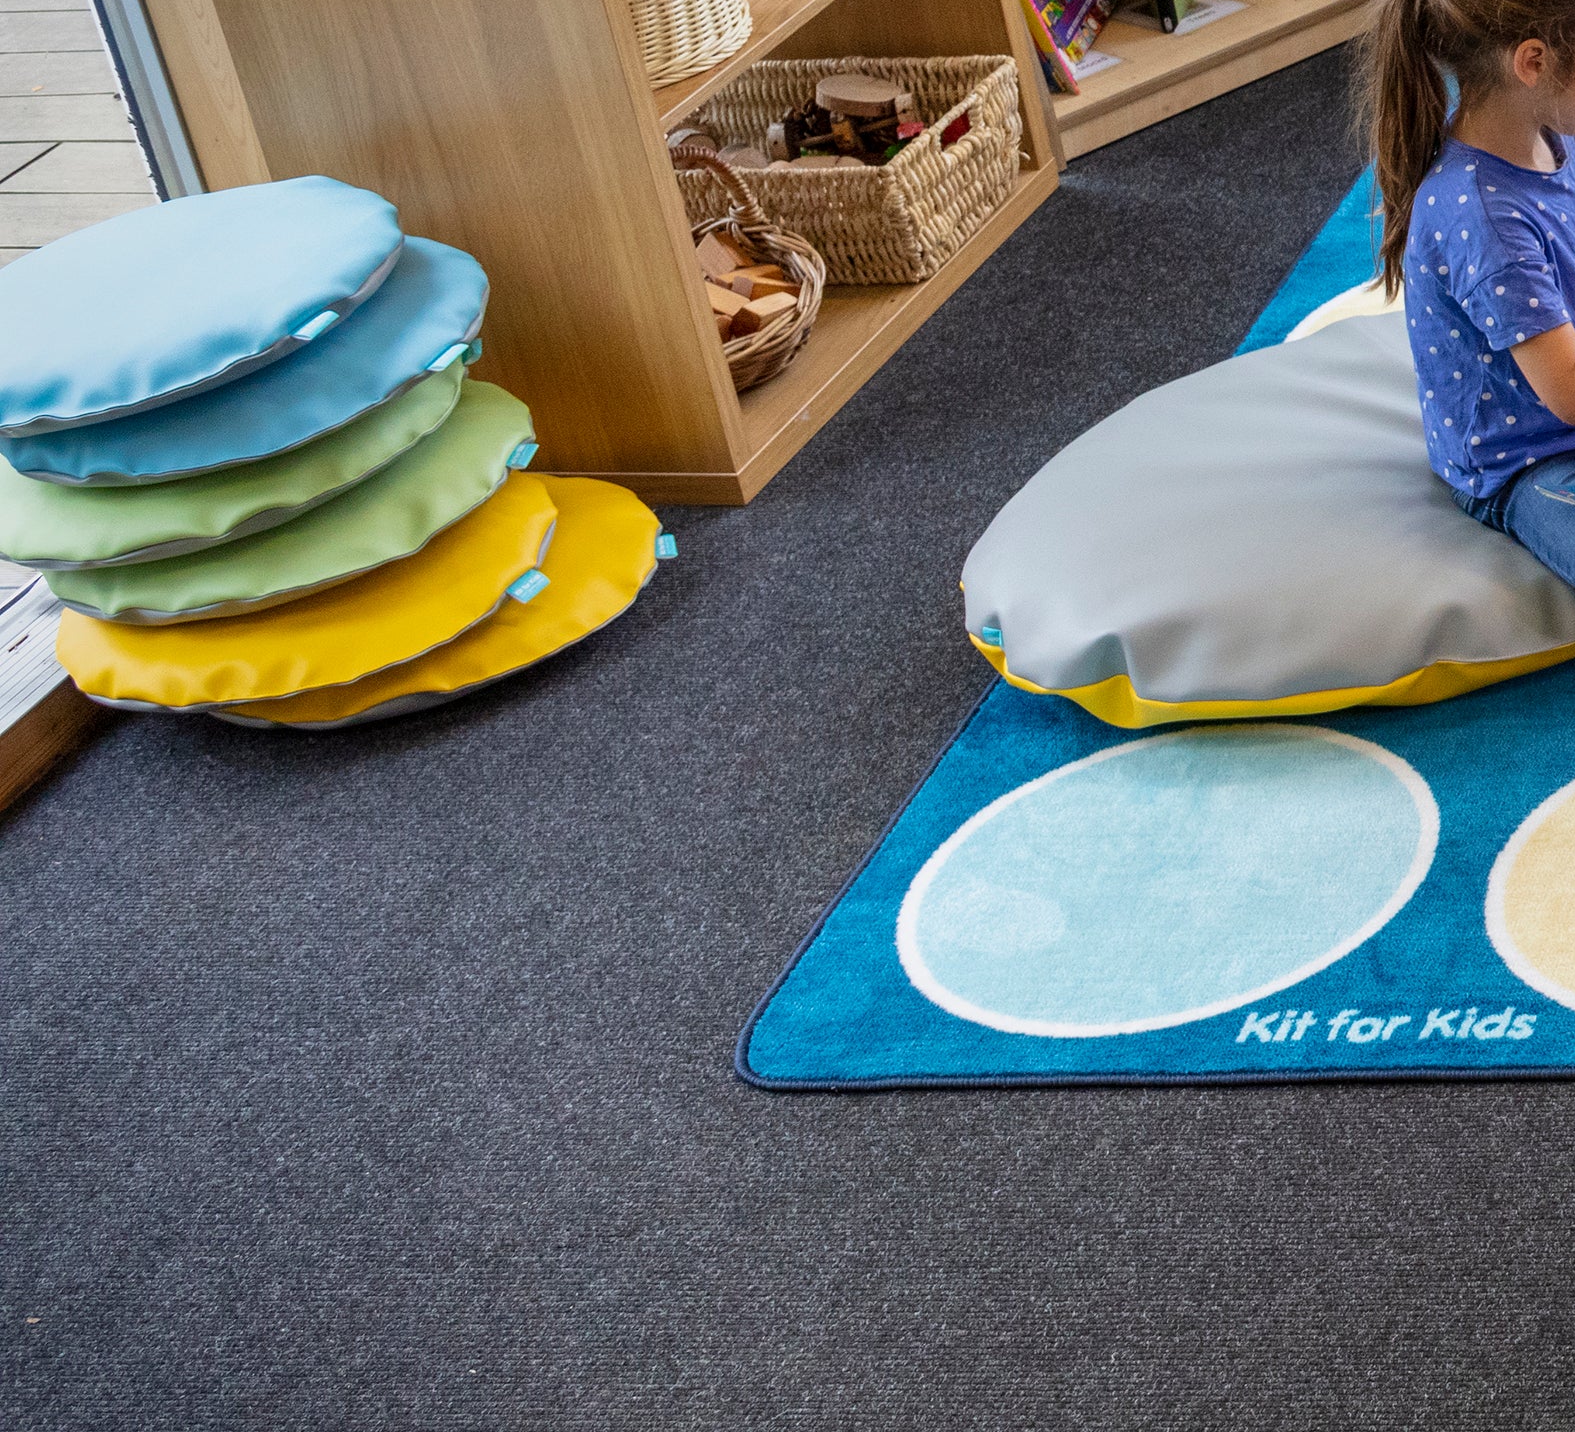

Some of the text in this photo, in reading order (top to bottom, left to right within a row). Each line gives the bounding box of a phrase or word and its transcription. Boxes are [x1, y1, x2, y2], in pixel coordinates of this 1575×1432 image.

[1235, 1006, 1538, 1043] Kit for Kids
